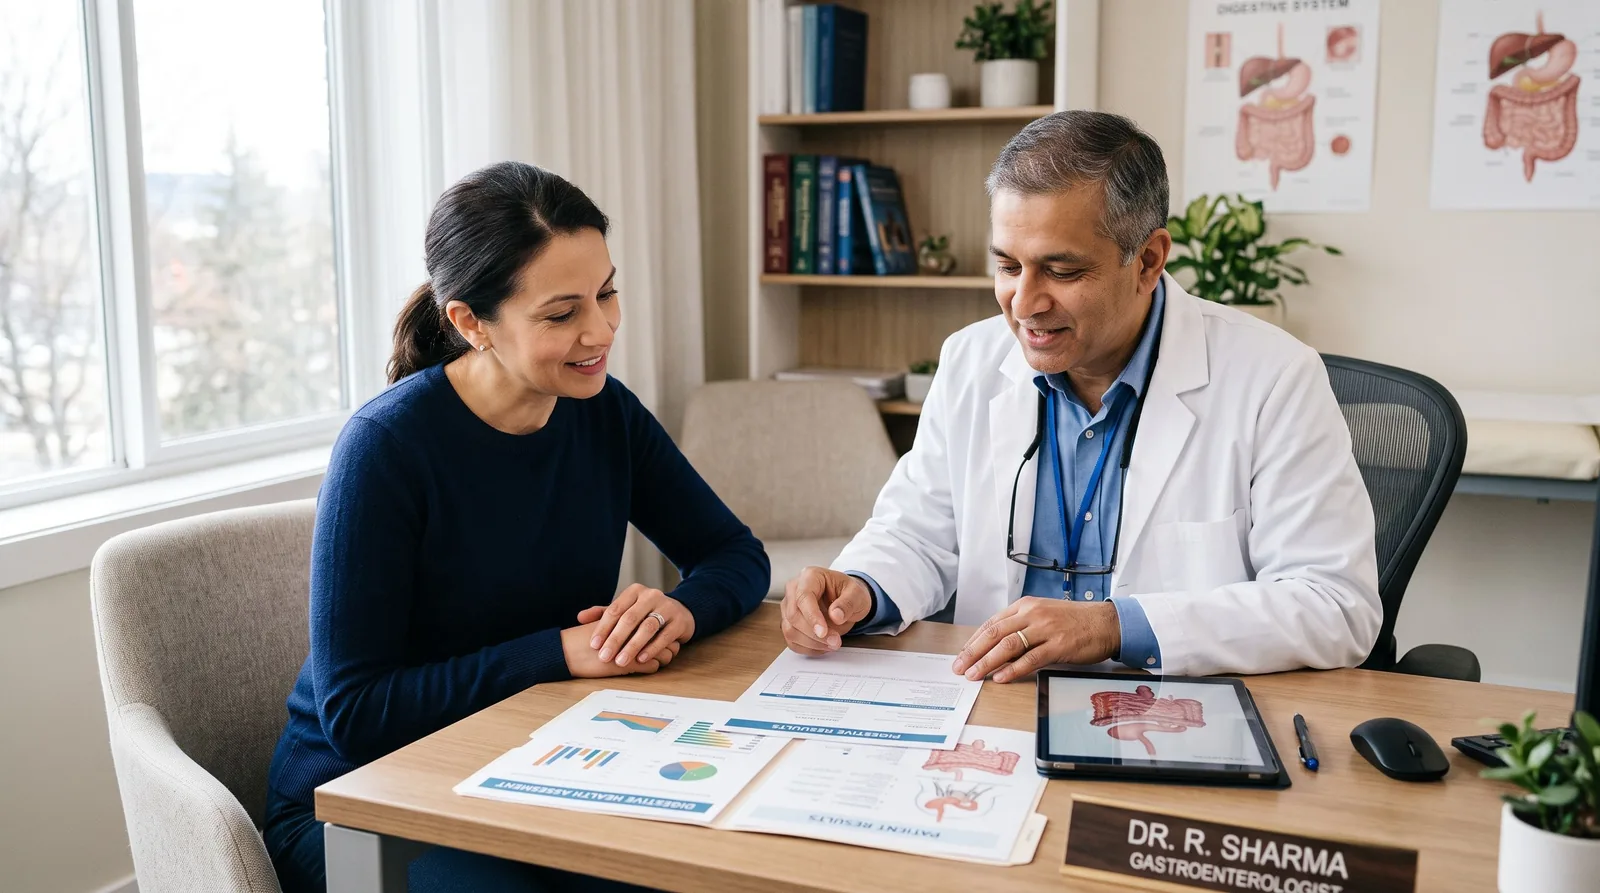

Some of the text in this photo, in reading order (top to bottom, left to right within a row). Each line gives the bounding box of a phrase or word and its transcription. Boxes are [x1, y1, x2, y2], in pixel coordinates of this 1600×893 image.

[495, 781, 697, 811] DIGESTIVE HEALTH ASSESMENT
[808, 815, 941, 838] PATIENT RESULTS
[1127, 818, 1349, 880] DR. R. SHARMA
